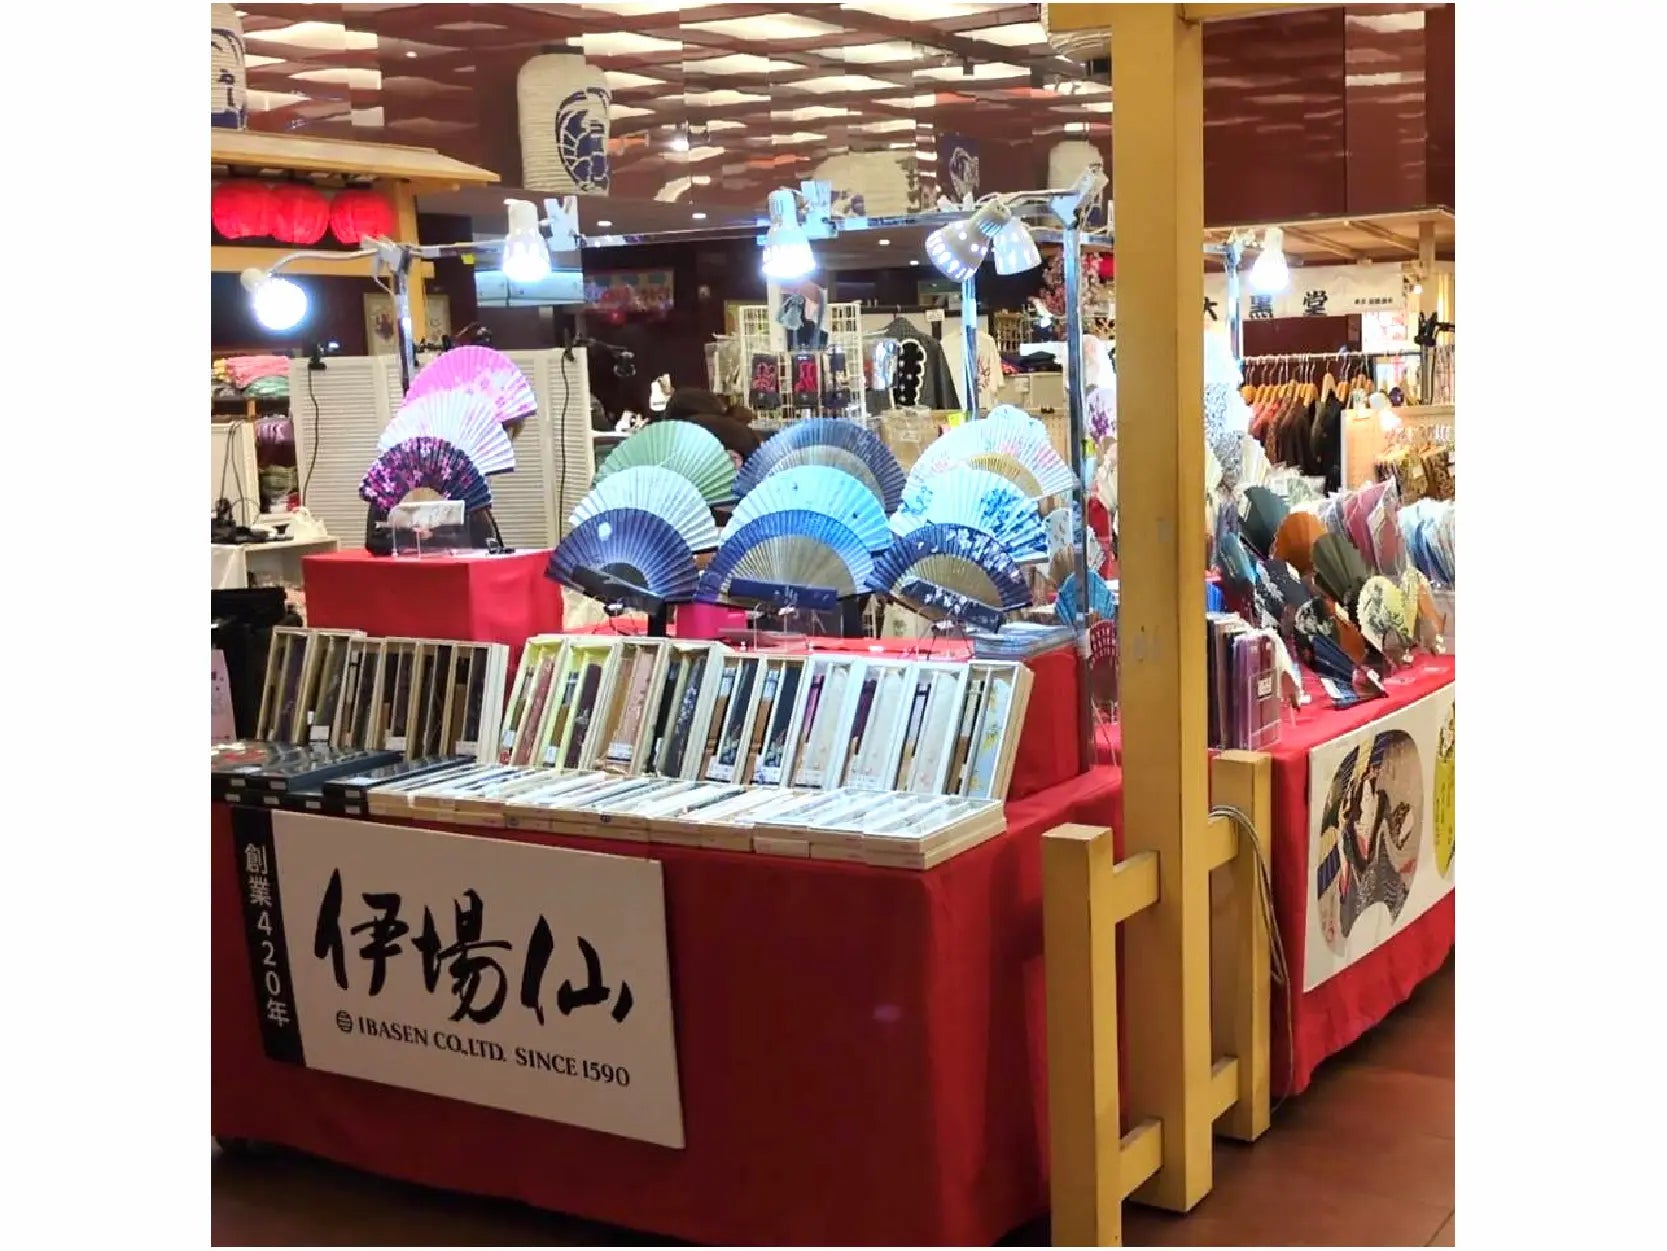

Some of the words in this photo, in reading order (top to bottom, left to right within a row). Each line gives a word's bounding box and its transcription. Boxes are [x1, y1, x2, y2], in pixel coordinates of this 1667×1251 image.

[245, 843, 290, 1027] 創業420年
[314, 867, 633, 1026] 伊場仙
[357, 1016, 429, 1047] IBASEN
[515, 1047, 578, 1077] SINCE
[582, 1060, 630, 1088] 1590
